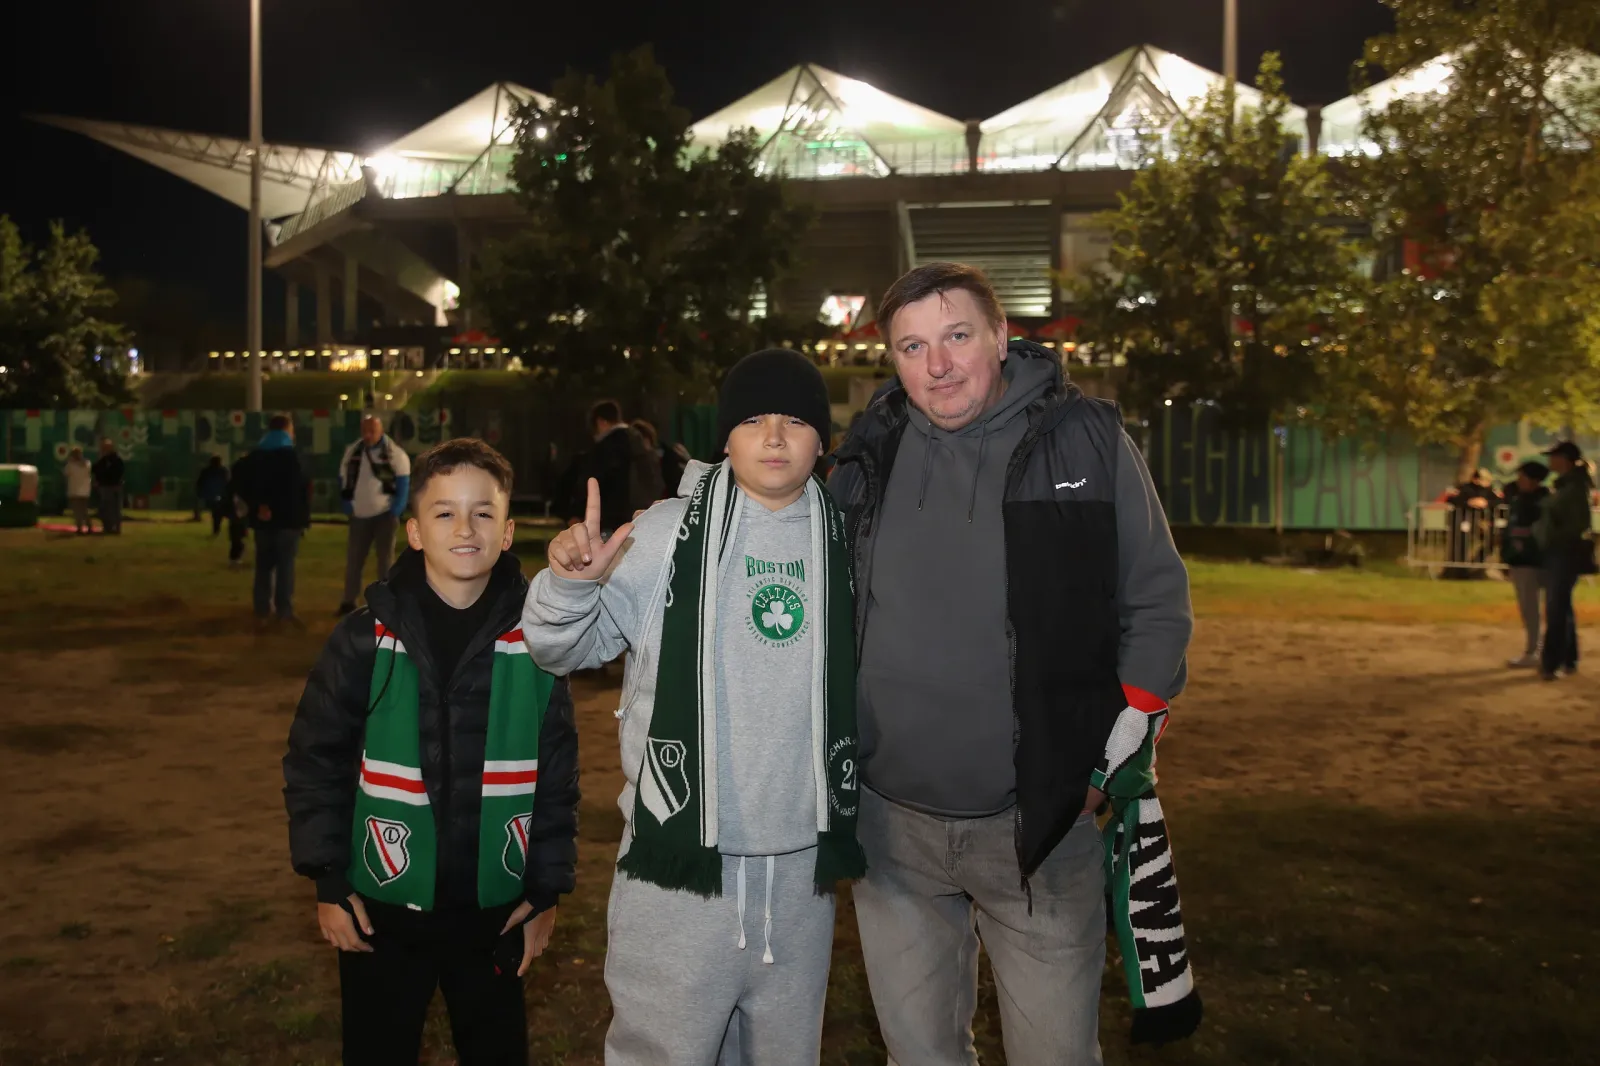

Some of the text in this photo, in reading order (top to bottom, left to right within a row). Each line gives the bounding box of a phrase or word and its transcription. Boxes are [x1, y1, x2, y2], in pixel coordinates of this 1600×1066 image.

[1152, 402, 1270, 525] LEGIA
[745, 555, 805, 582] BOSTON
[746, 577, 808, 602] ATLANTIC DIVISION
[755, 587, 801, 610] CELTICS
[745, 616, 810, 648] EASTERN CONFERENCE
